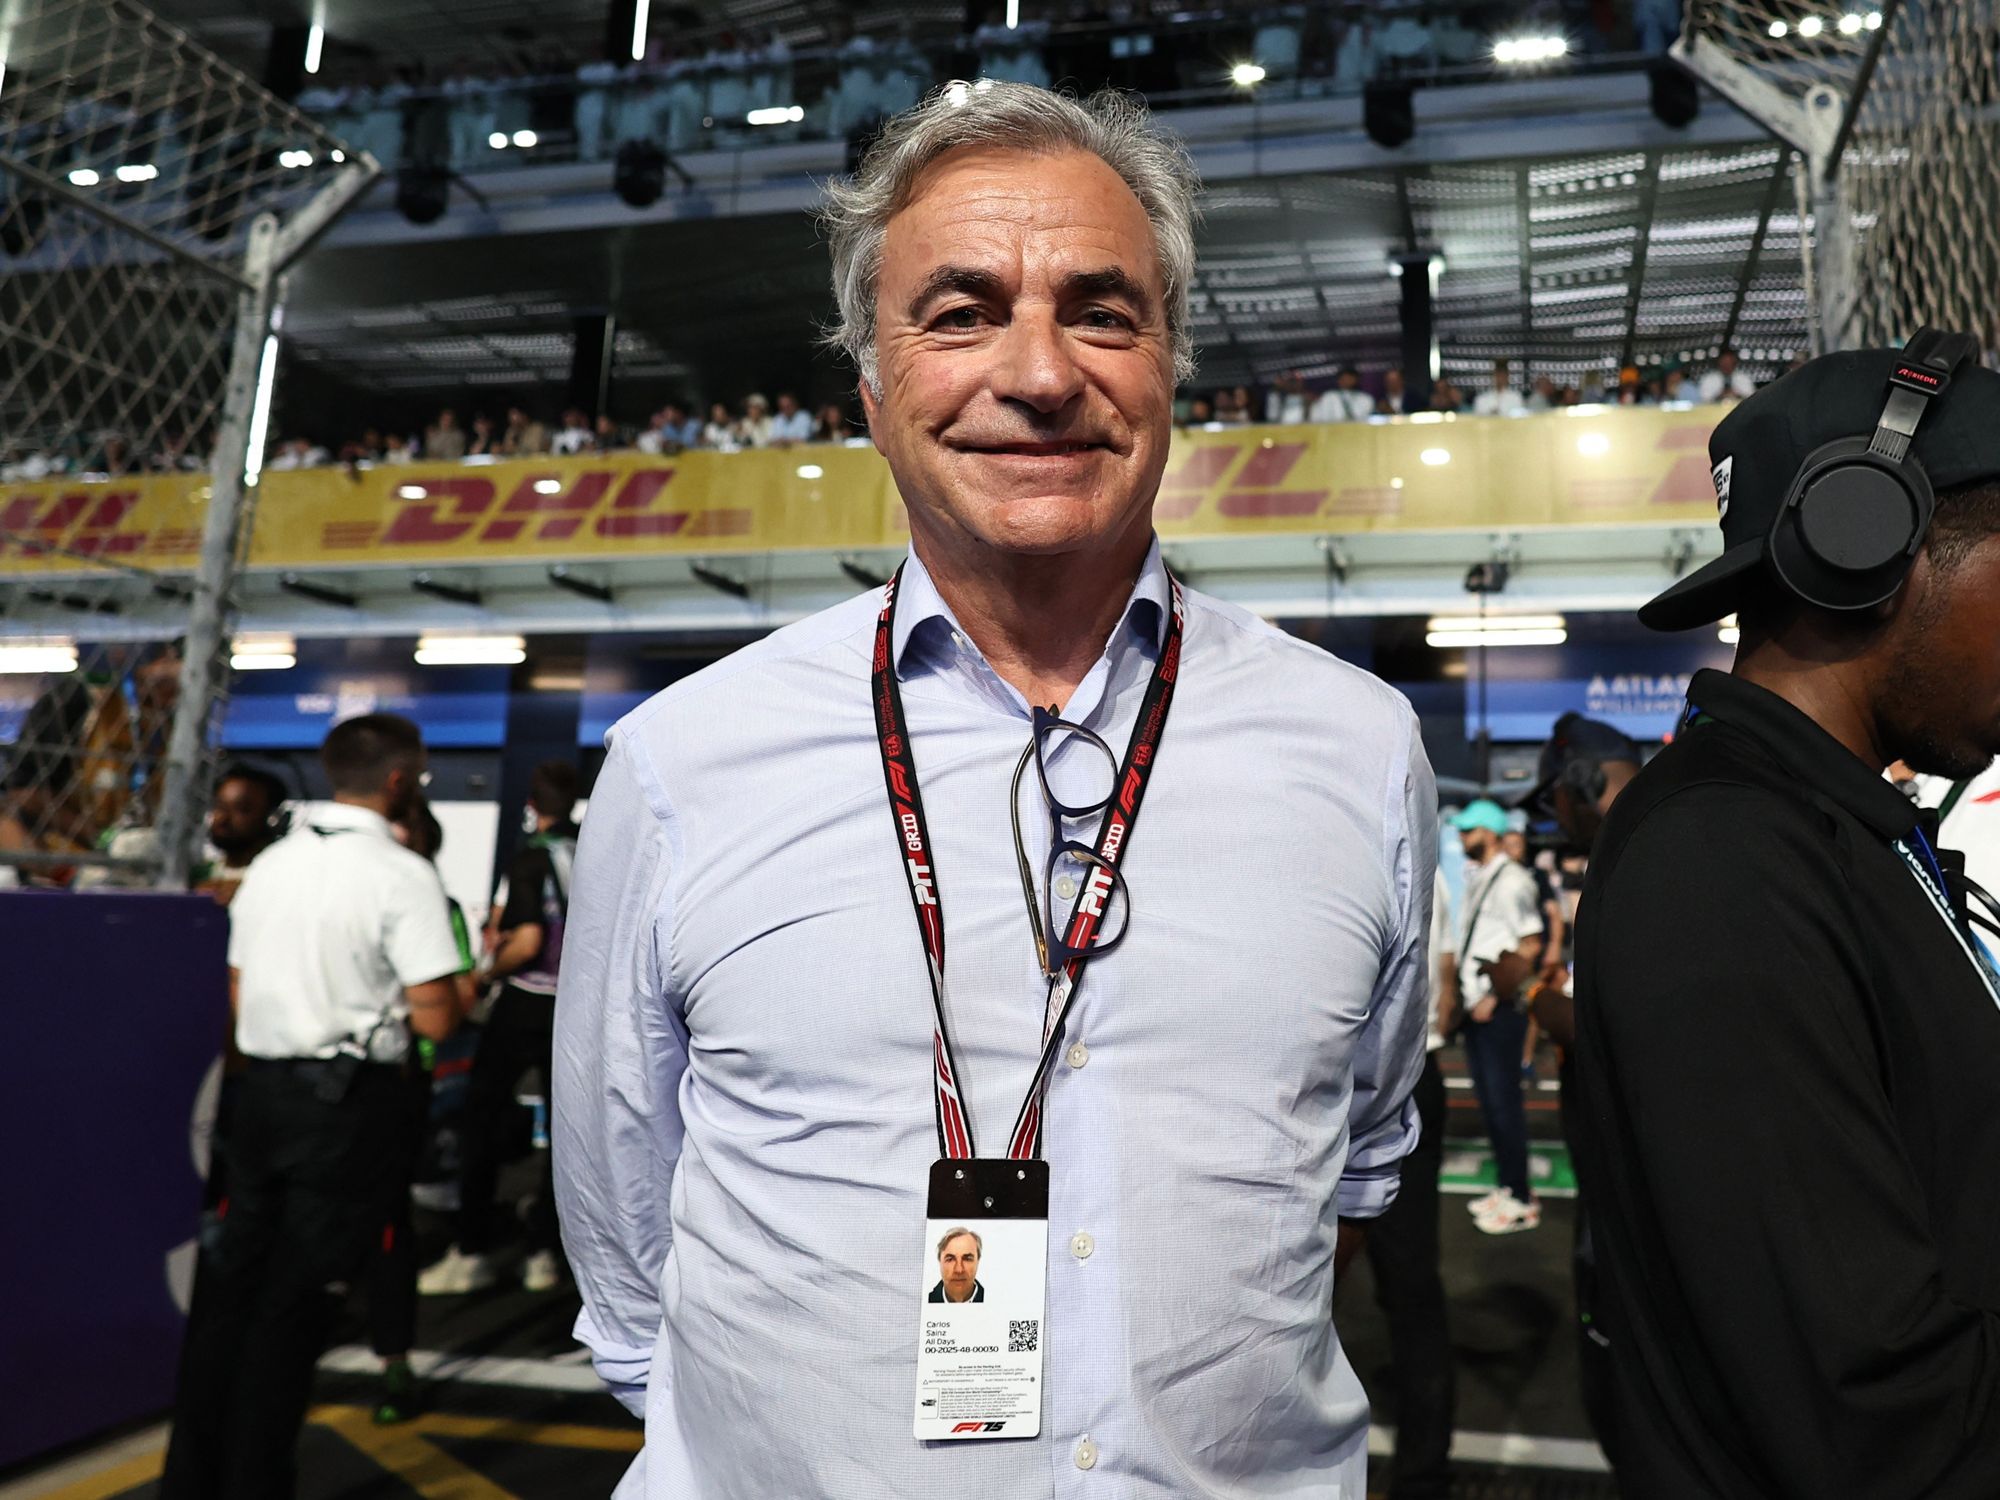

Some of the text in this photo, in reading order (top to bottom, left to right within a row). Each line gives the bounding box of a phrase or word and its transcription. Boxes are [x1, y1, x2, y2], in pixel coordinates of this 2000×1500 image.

[1911, 372, 1938, 385] RIEDEL
[380, 468, 690, 544] DHL
[1160, 632, 1180, 684] 2025
[901, 813, 937, 905] PIT GRID
[1078, 823, 1125, 917] PIT GRID
[926, 1329, 946, 1337] Sainz
[936, 1338, 956, 1346] Days
[982, 1421, 1007, 1432] 75
